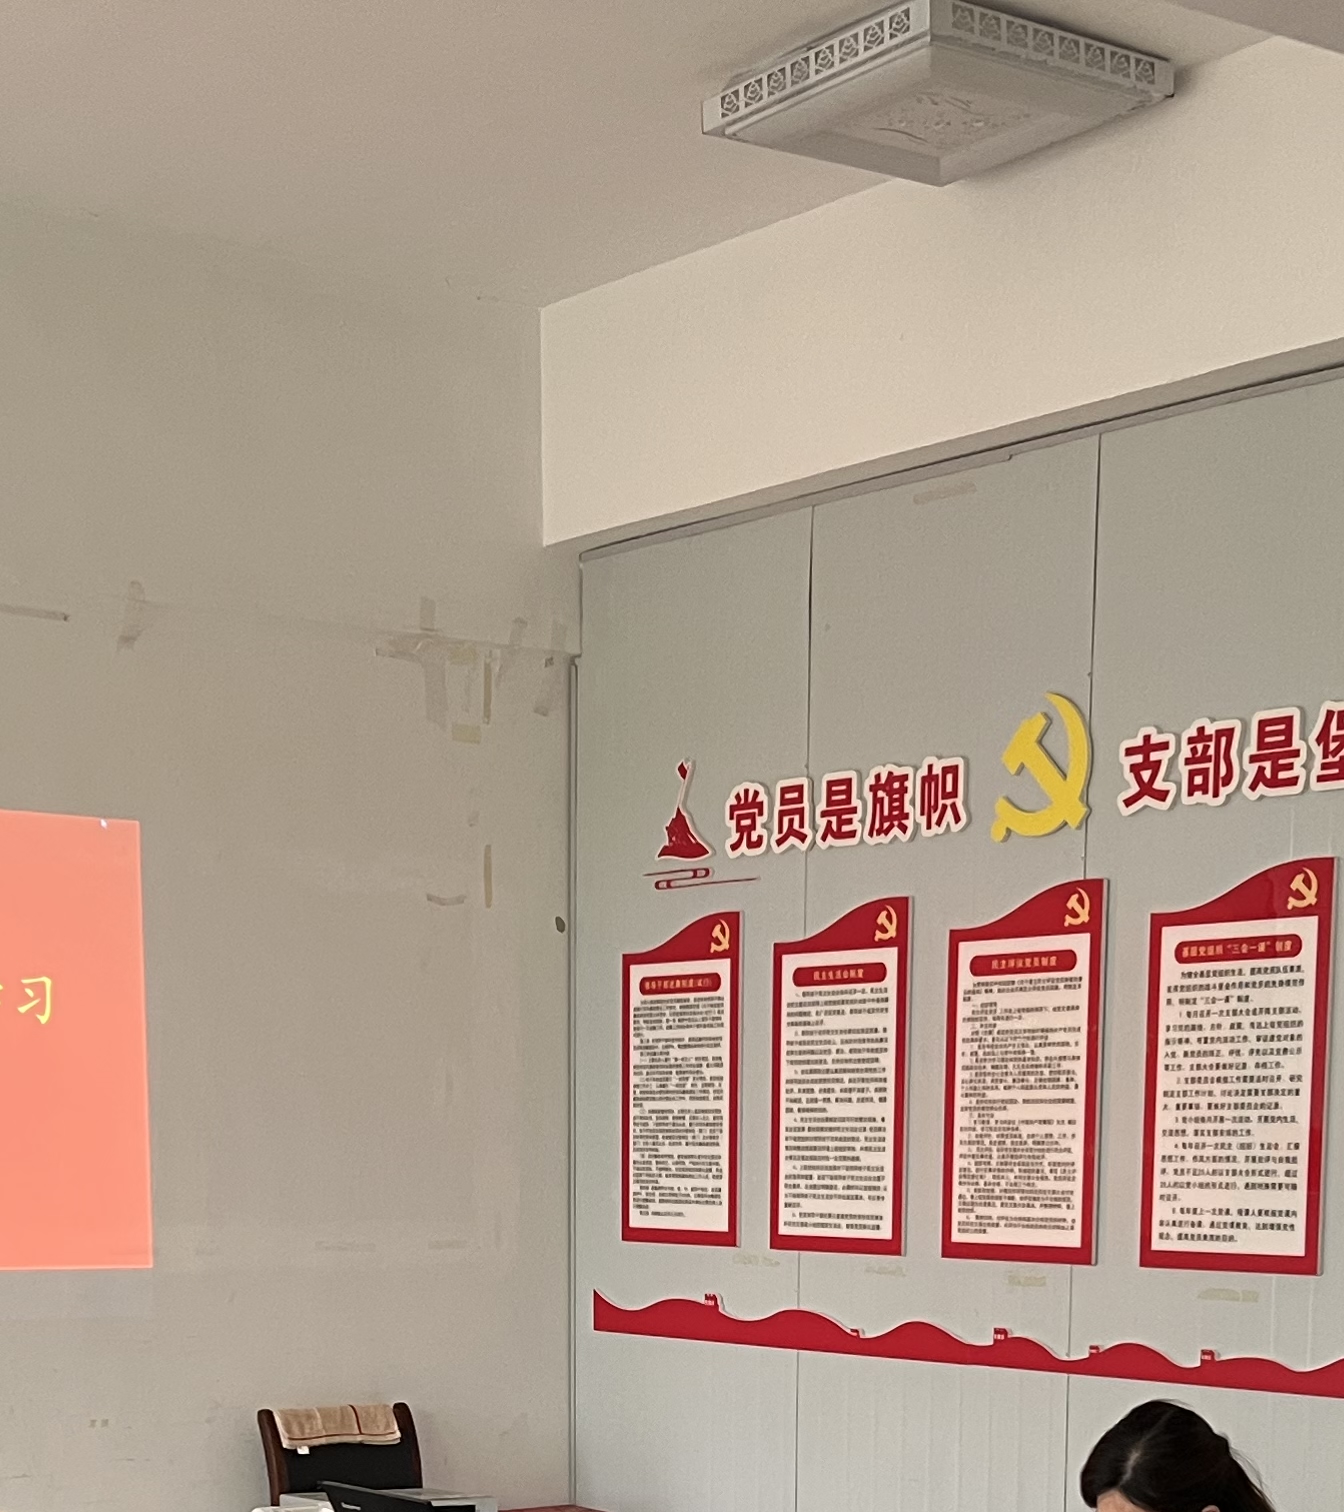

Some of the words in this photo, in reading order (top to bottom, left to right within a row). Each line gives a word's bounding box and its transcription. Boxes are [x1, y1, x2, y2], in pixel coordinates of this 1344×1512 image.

[725, 760, 966, 855] 党员是旗帜
